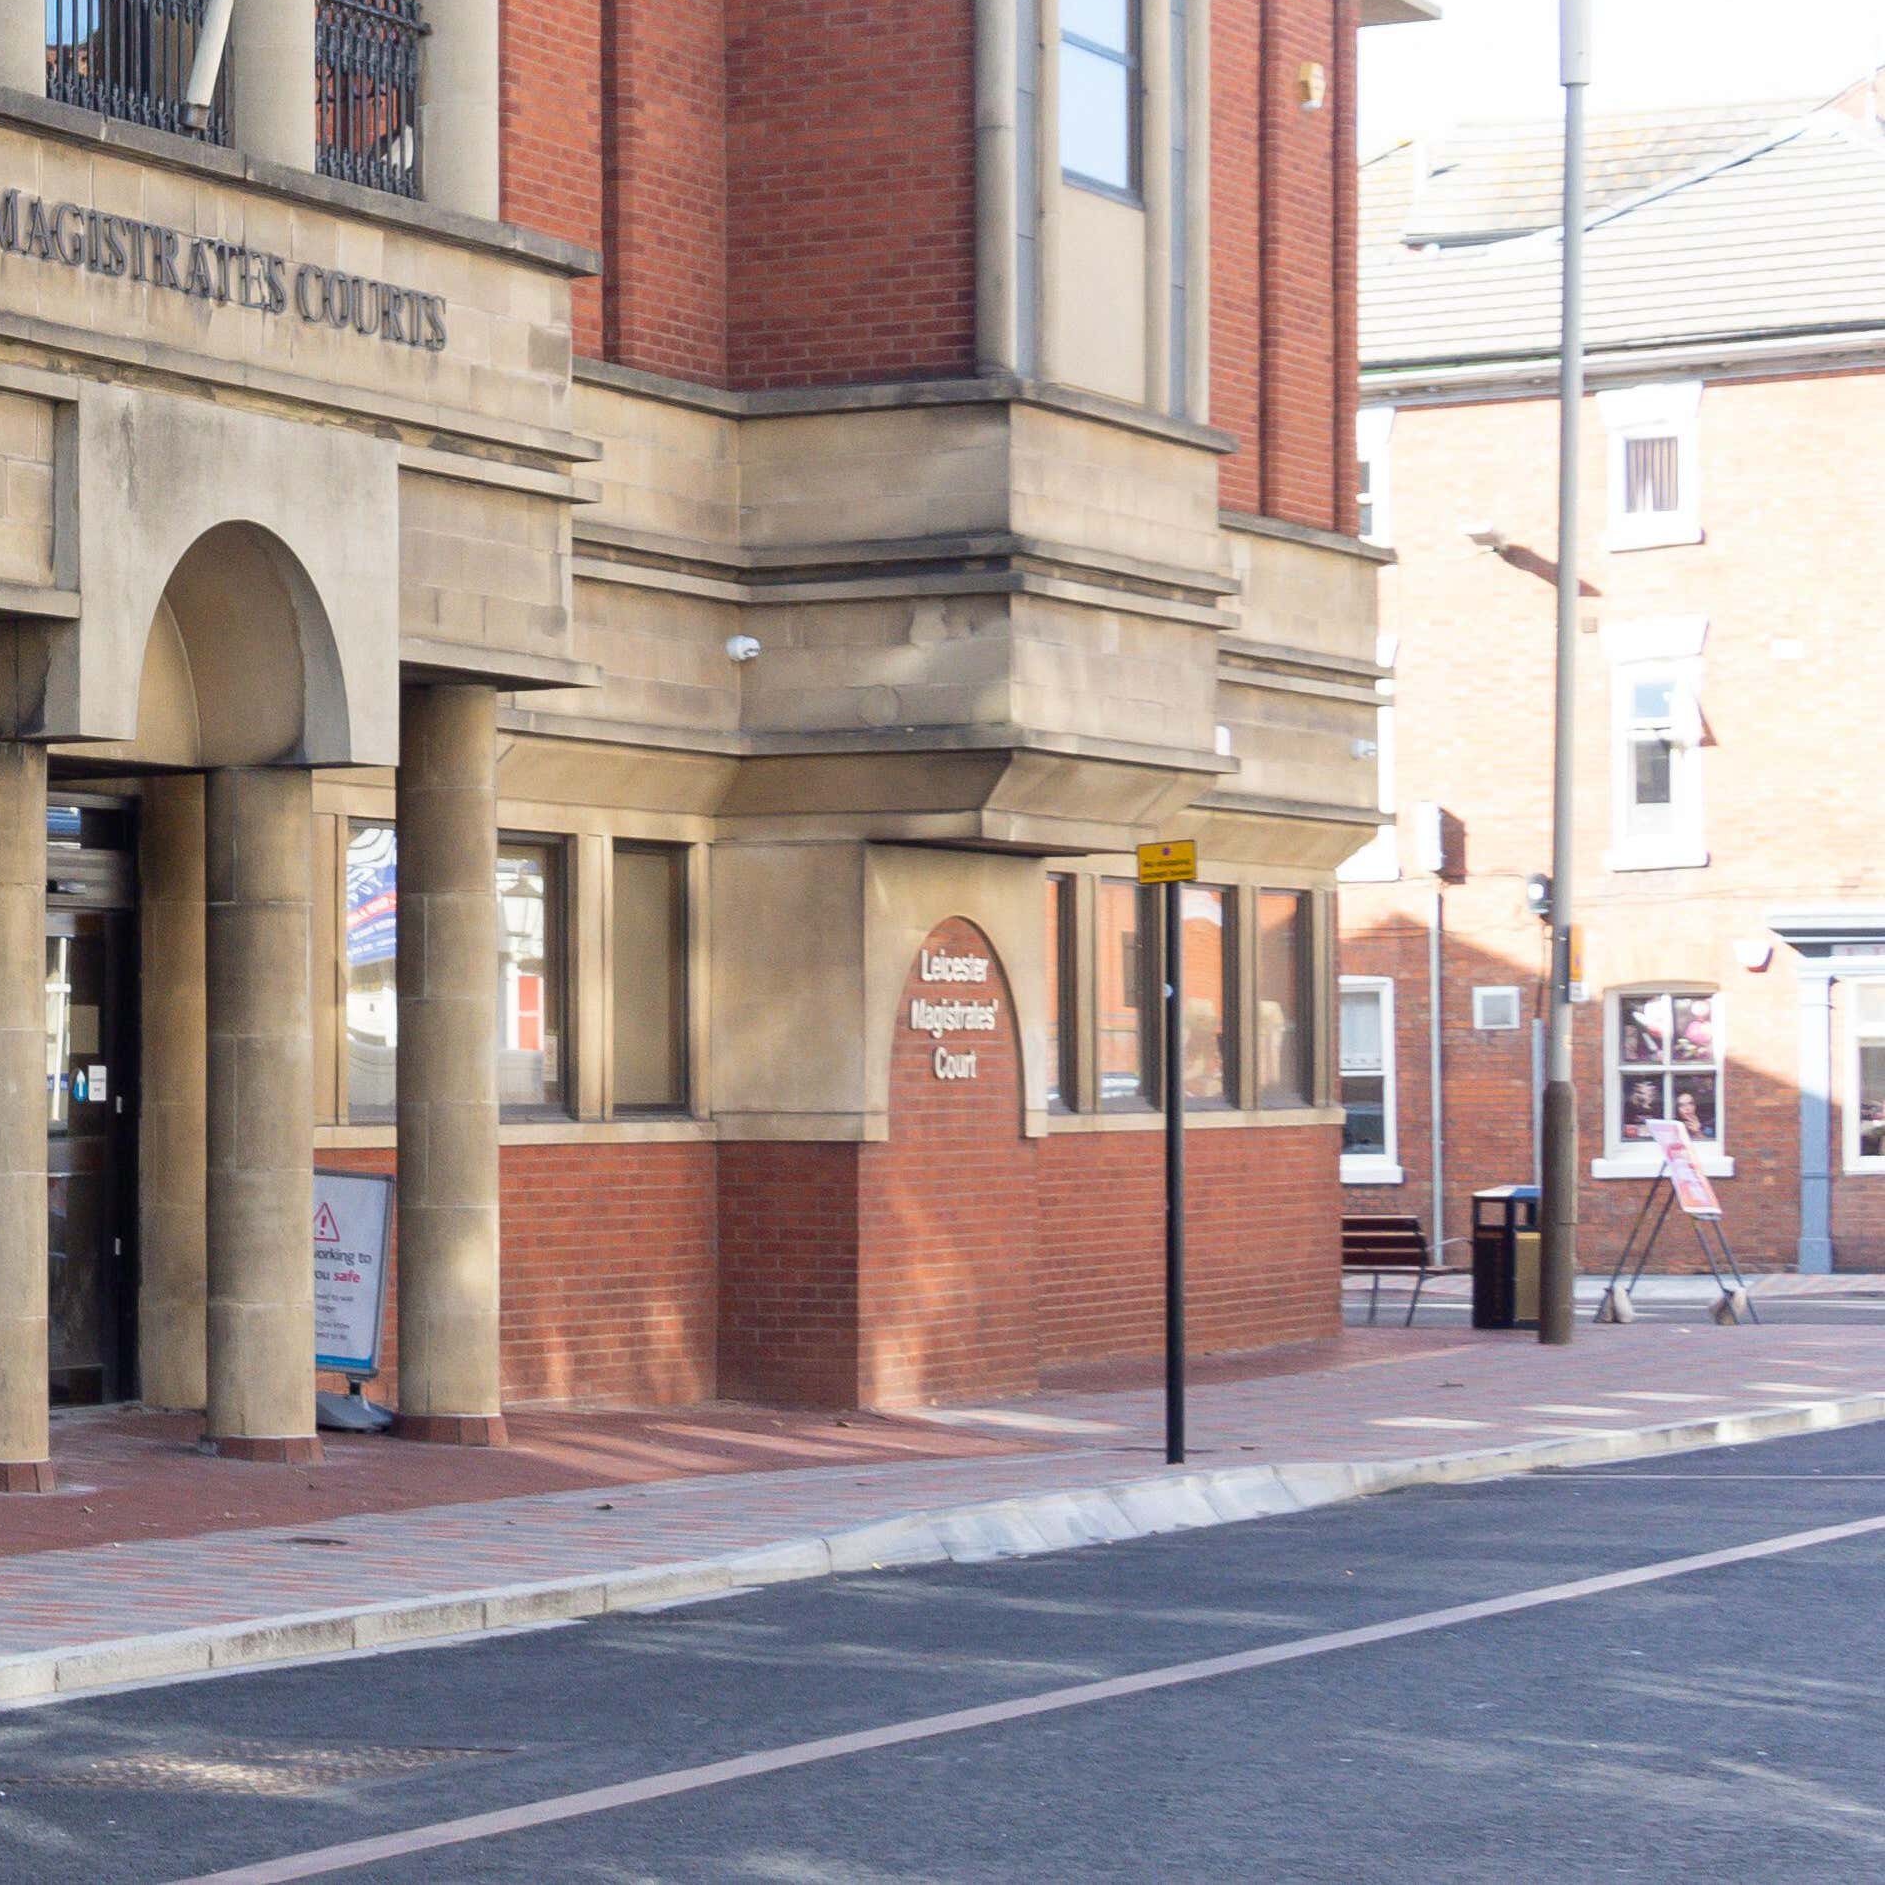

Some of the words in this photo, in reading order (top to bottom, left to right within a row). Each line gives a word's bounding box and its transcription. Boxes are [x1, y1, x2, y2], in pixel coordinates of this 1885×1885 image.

[295, 262, 447, 352] COURTS
[921, 948, 989, 983] Leicester
[911, 997, 999, 1038] Magistrates'
[935, 1046, 977, 1079] Court
[358, 1252, 372, 1264] to
[333, 1269, 361, 1283] safe
